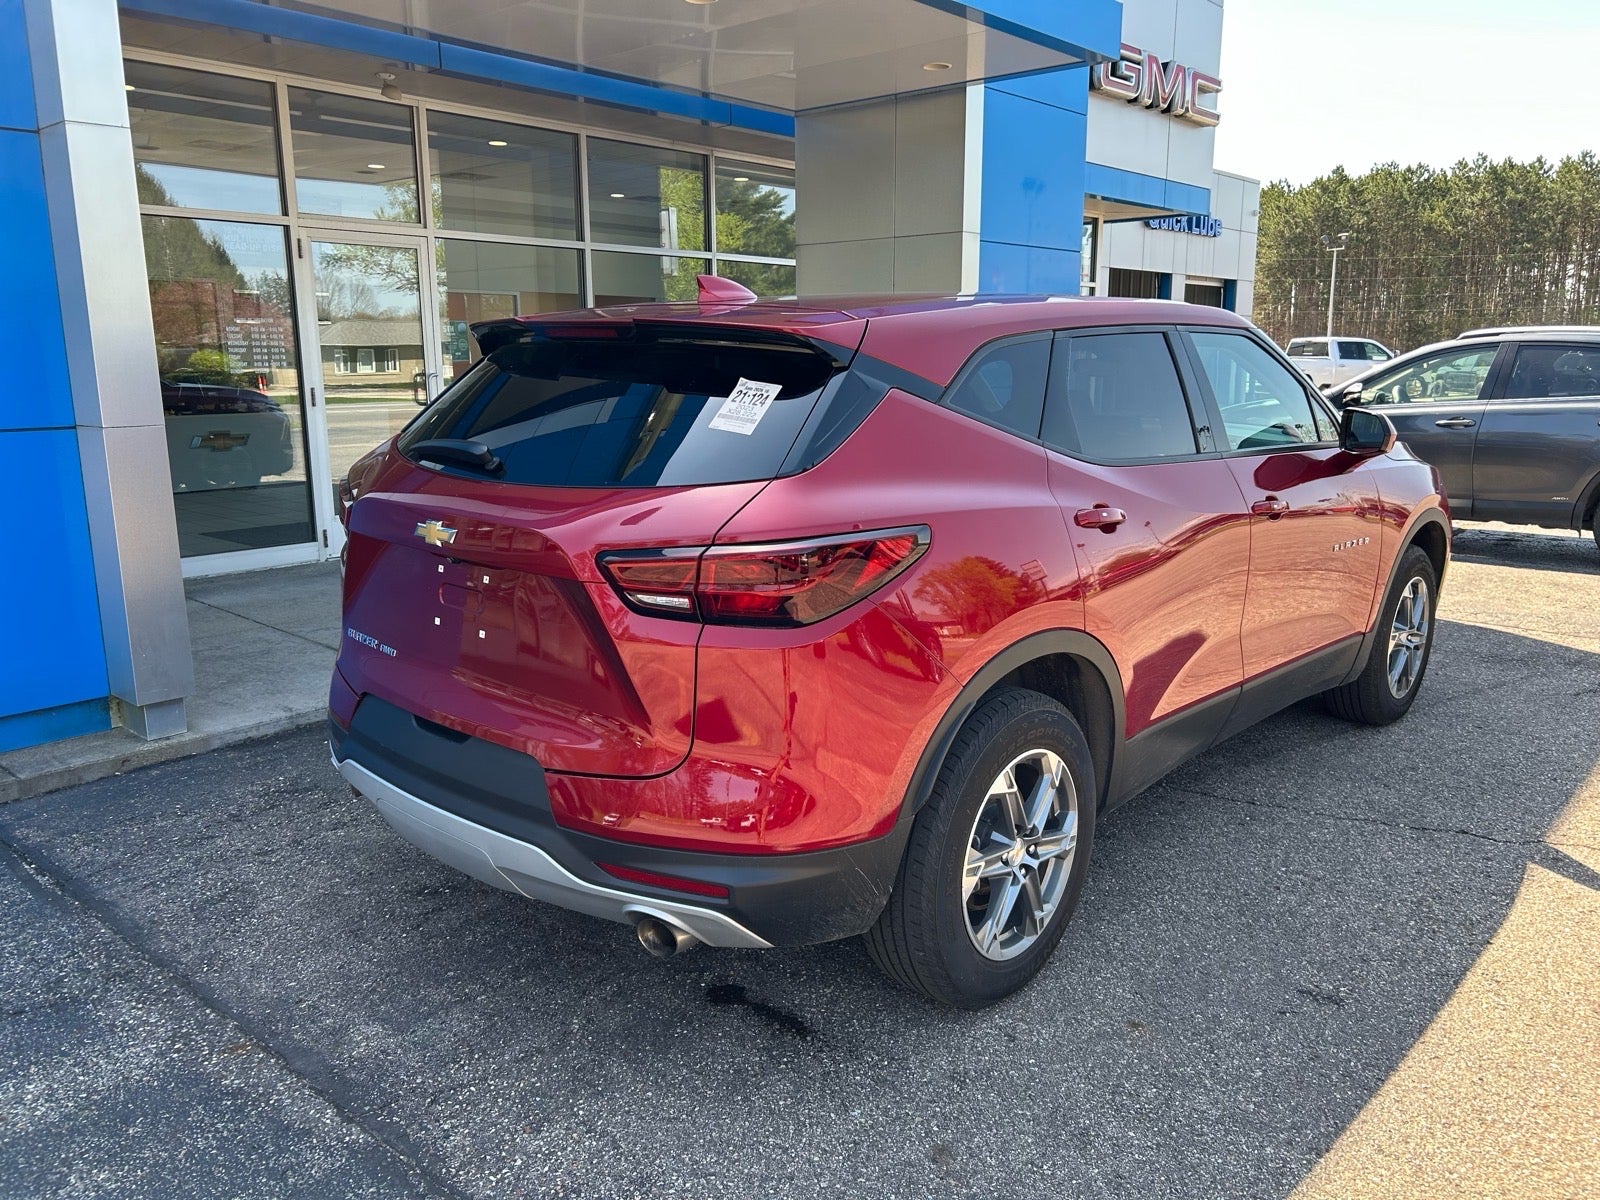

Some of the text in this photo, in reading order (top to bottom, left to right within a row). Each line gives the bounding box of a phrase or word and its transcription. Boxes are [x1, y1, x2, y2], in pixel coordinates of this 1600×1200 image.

[1095, 42, 1221, 126] GMC
[1192, 215, 1222, 237] Lube
[1332, 537, 1369, 552] BLAZER
[347, 627, 397, 657] BLAZER AWD
